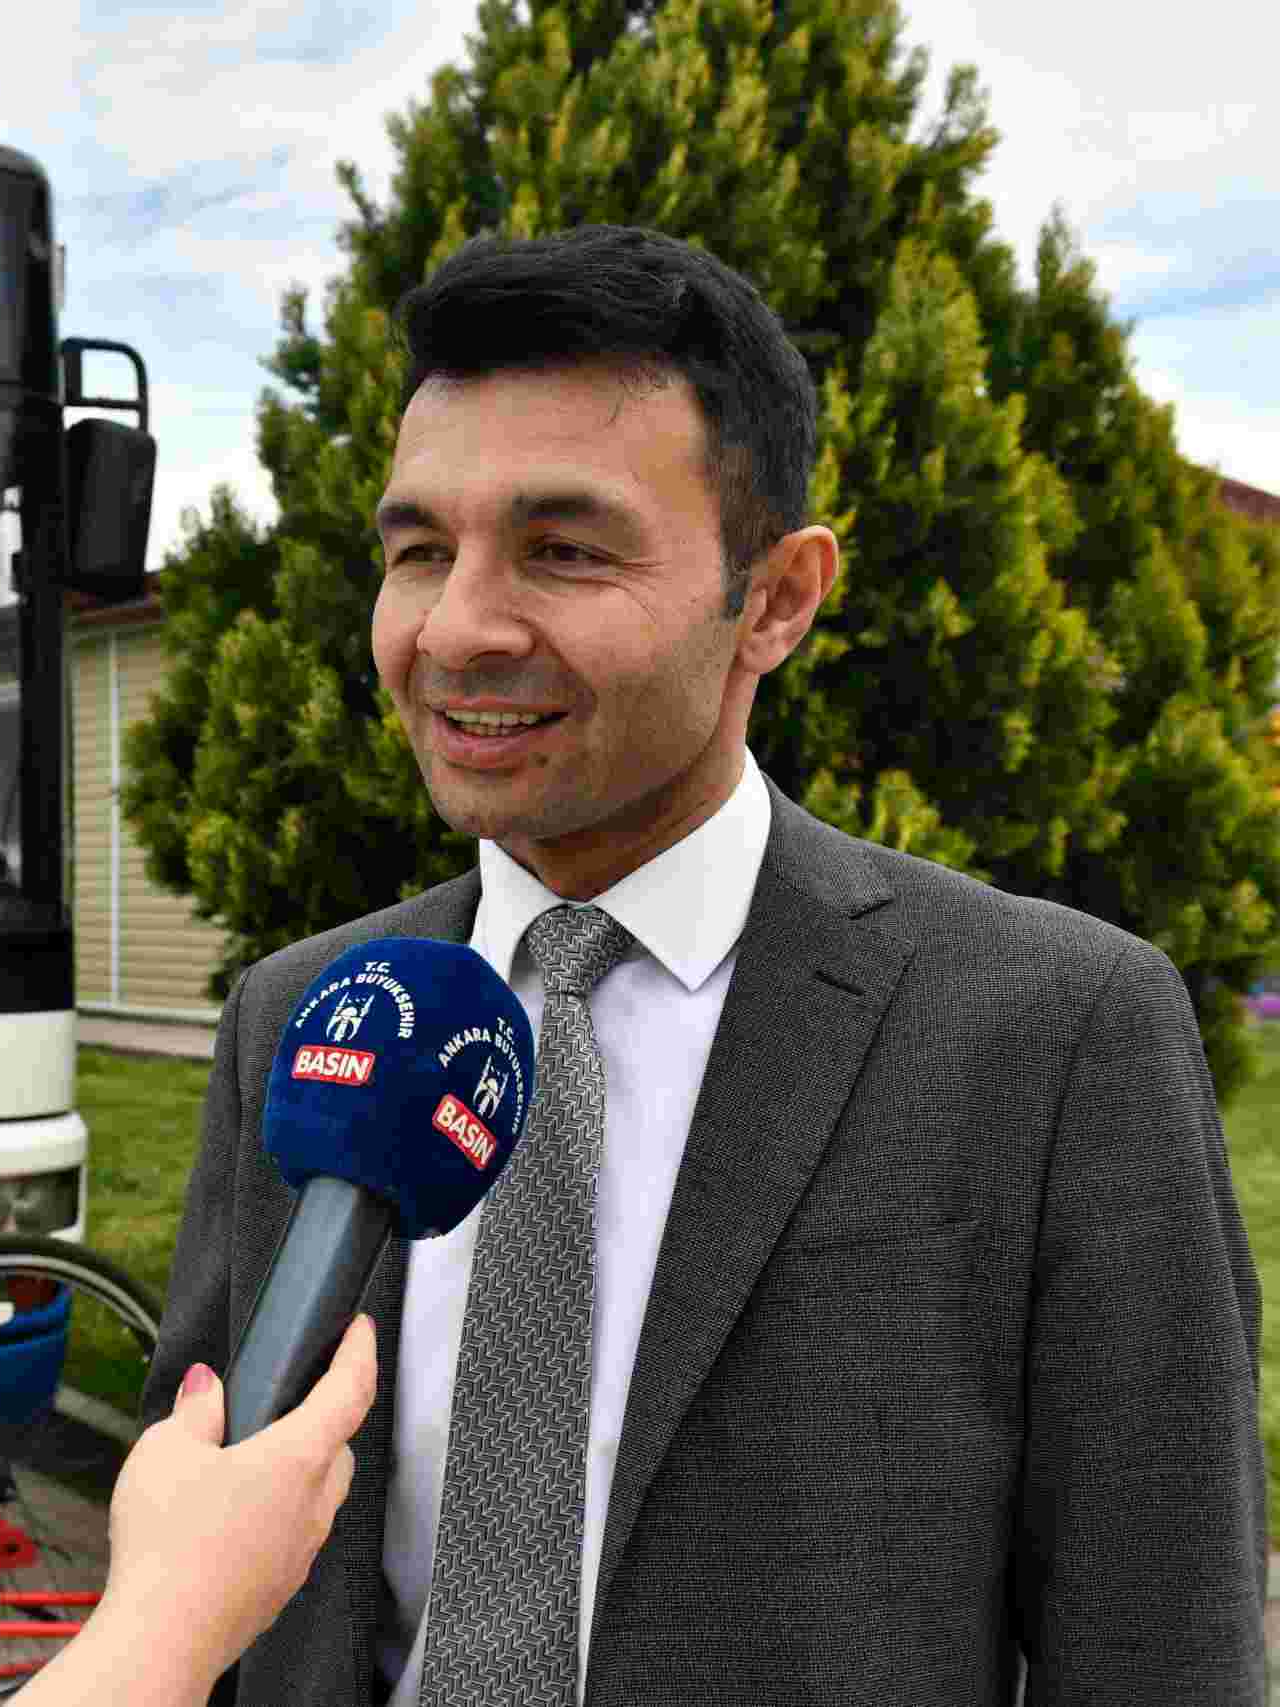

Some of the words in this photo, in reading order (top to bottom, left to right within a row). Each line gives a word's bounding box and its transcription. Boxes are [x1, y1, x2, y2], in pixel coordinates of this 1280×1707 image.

[295, 1050, 370, 1081] BASIN
[437, 1026, 492, 1069] ANKARA
[436, 1100, 495, 1166] BASIN
